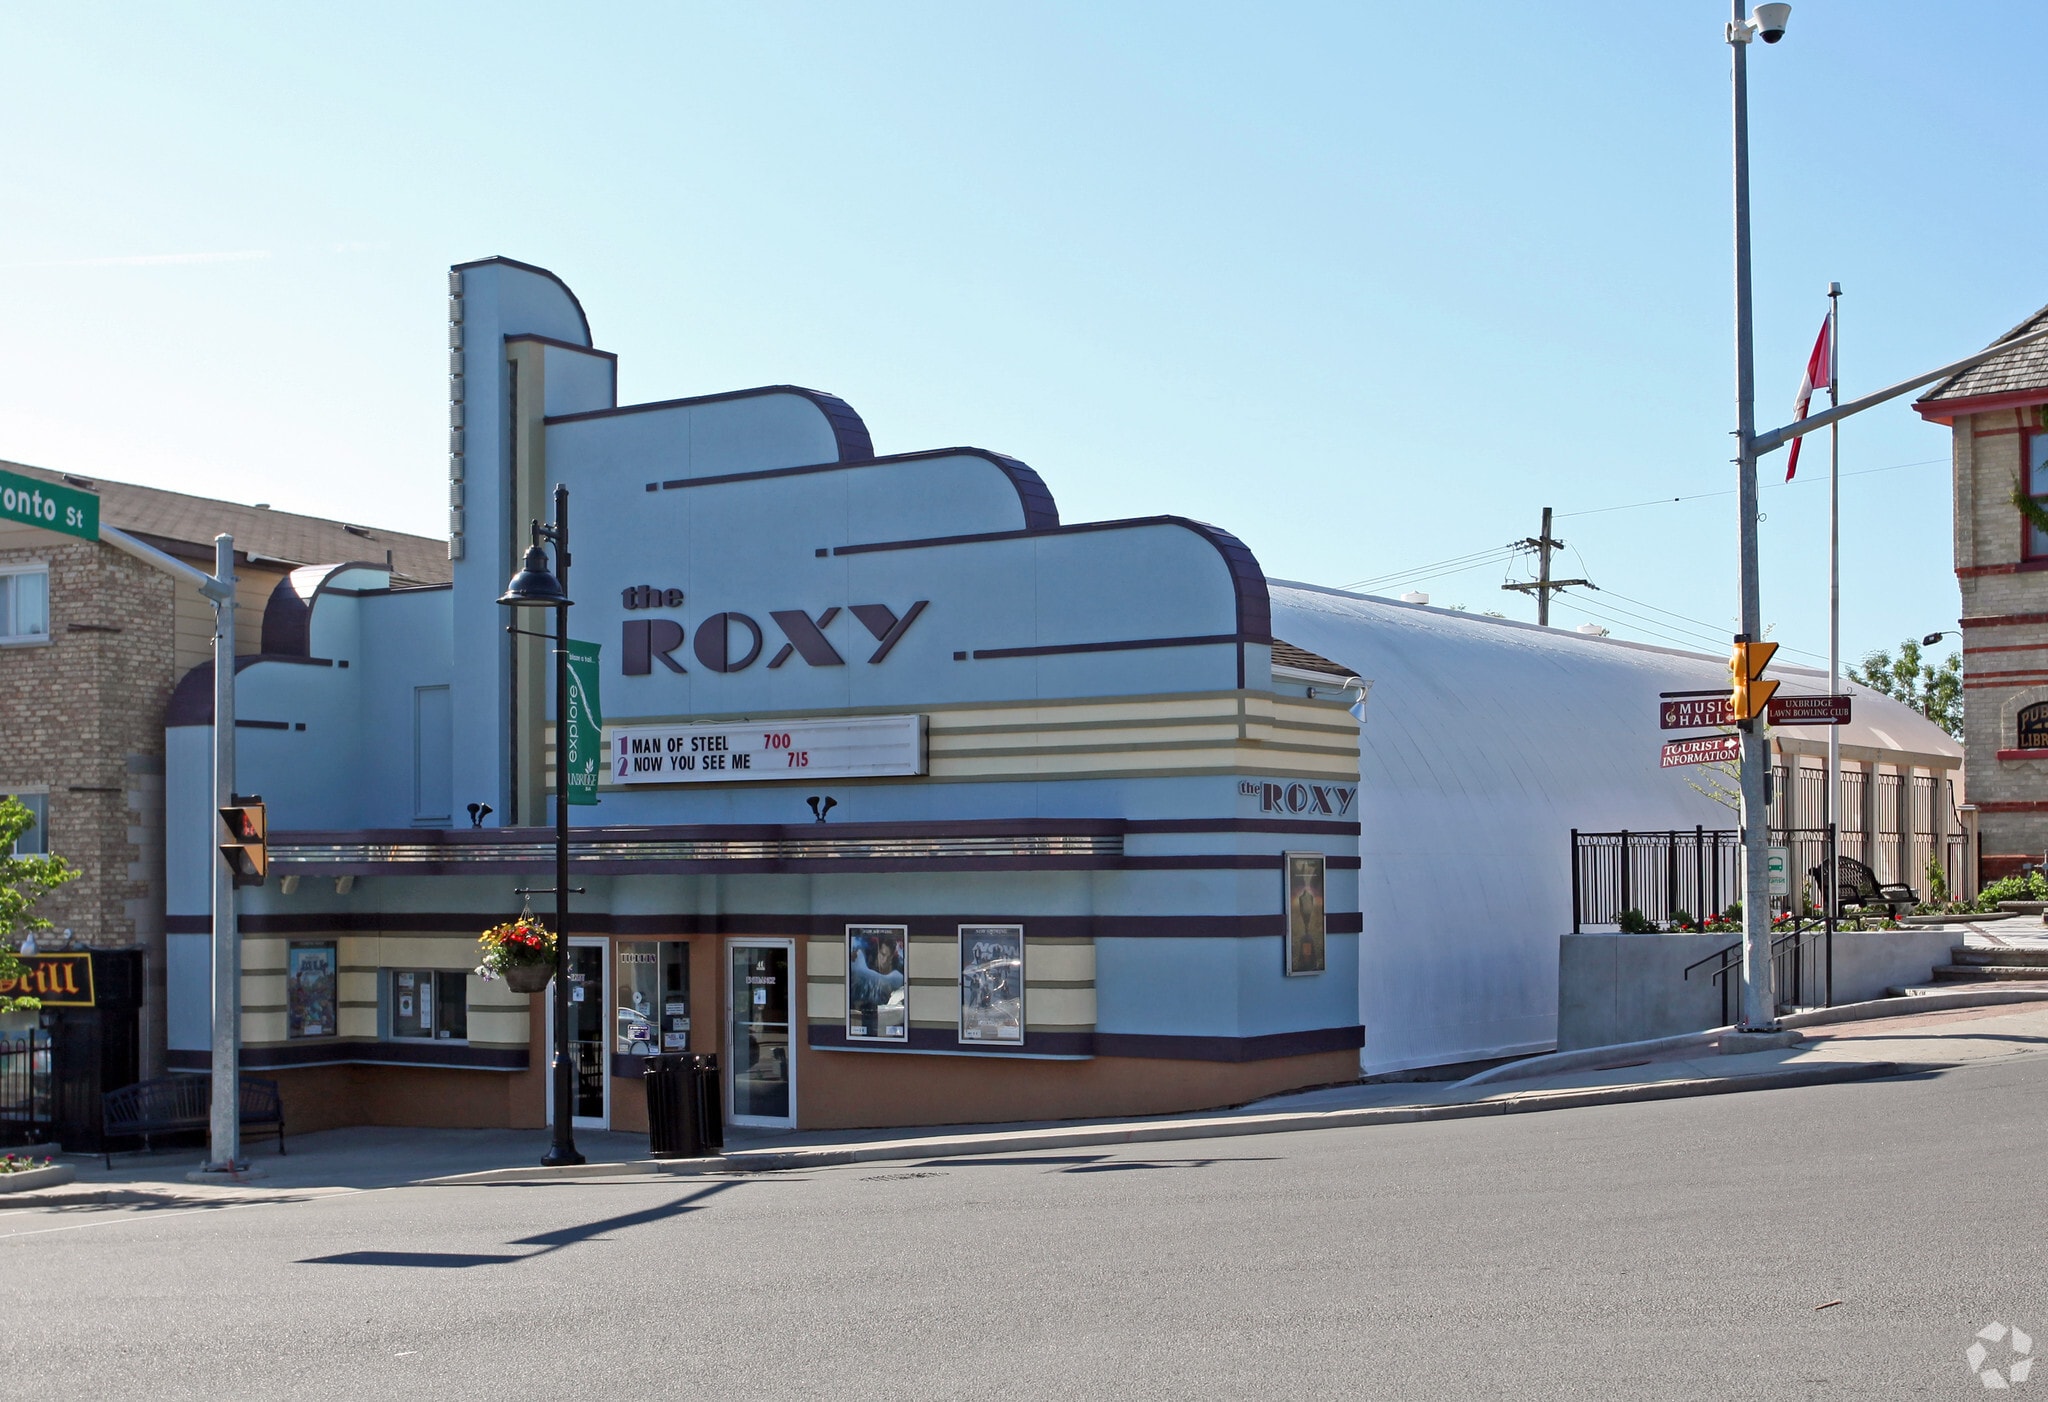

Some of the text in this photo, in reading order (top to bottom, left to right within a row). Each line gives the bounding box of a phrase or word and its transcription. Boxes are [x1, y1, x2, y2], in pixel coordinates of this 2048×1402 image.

[0, 486, 83, 528] onto St
[621, 585, 684, 610] the
[622, 600, 930, 675] ROXY
[1680, 701, 1734, 714] MUSIC
[1769, 708, 1849, 717] LAWN BOWLING CLUB
[1785, 700, 1833, 708] UXBRIDGE
[568, 685, 578, 763] explore
[1680, 713, 1724, 726] HALL
[618, 733, 791, 755] 1 MAN OF STEEL 700
[1664, 740, 1721, 756] TOURIST
[618, 752, 809, 776] 2 NOW YOU SEE ME 715
[1662, 749, 1737, 767] INFORMATION
[1240, 781, 1357, 815] the ROXY
